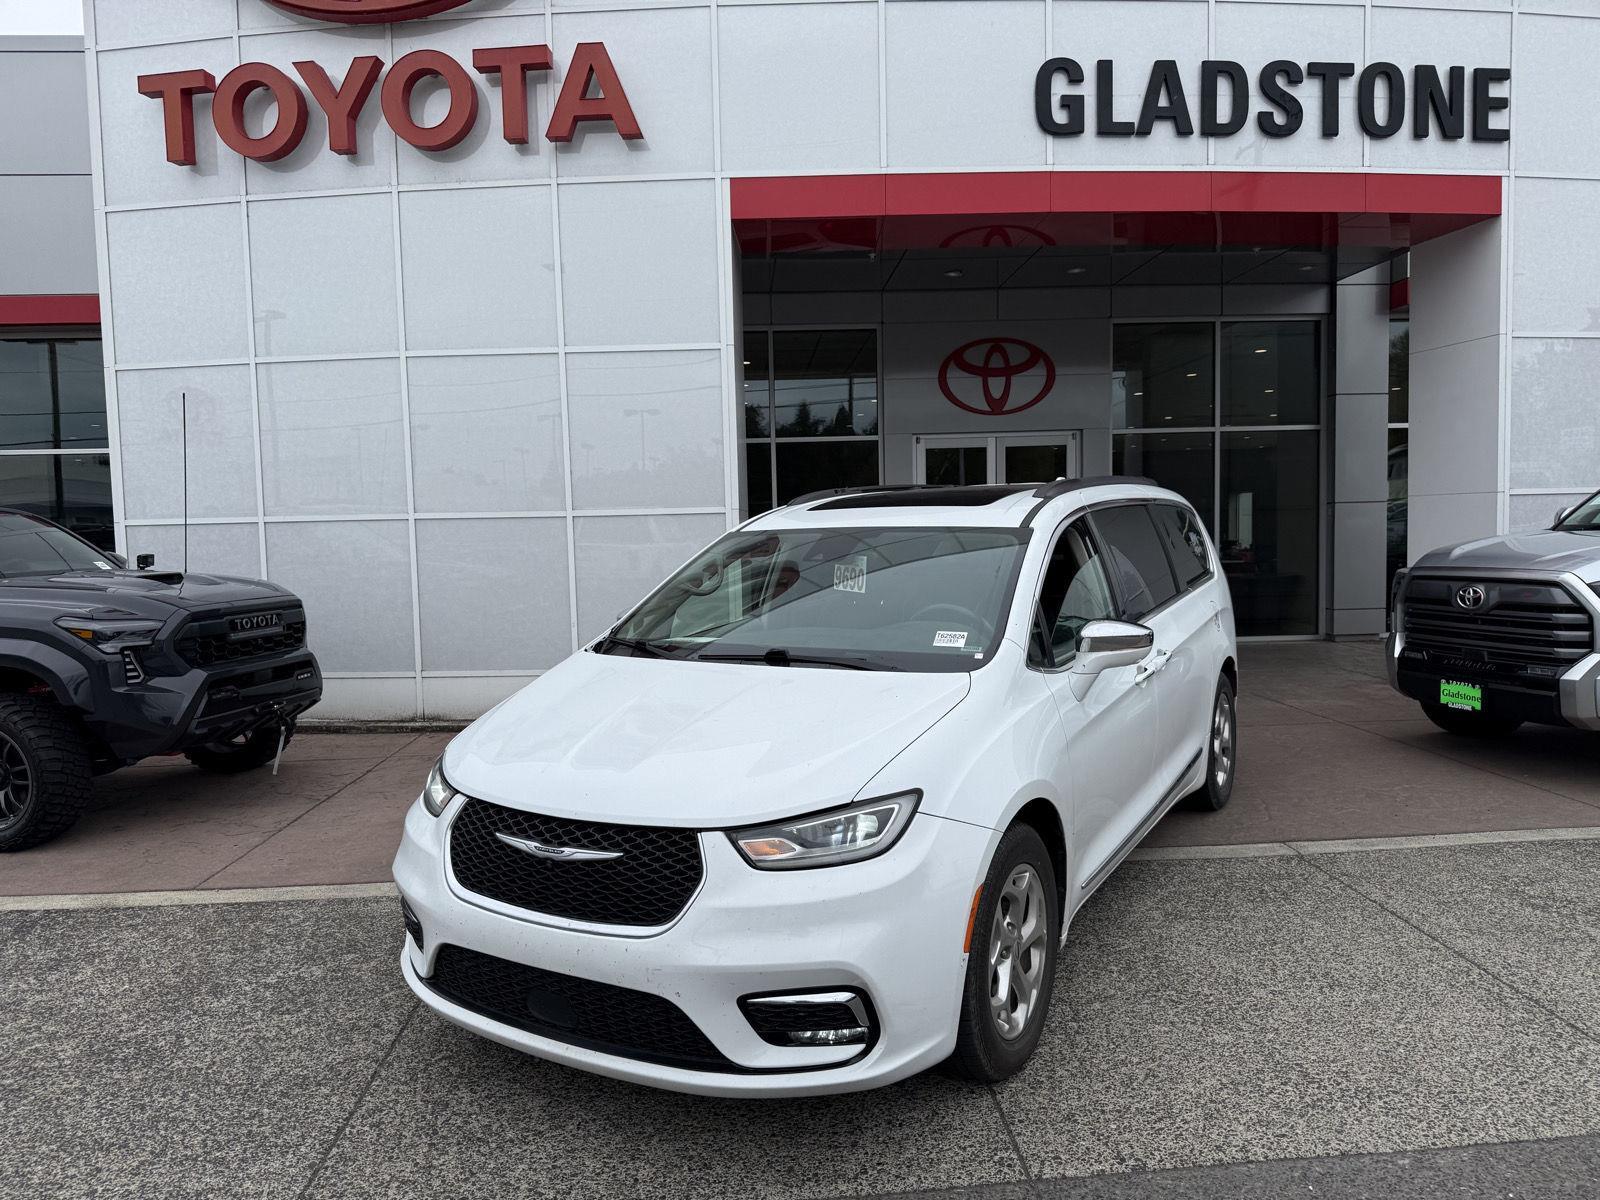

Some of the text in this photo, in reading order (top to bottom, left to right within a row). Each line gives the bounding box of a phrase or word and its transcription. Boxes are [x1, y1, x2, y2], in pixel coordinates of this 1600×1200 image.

[137, 42, 645, 167] TOYOTA
[1035, 57, 1510, 142] GLADSTONE
[835, 565, 865, 591] 9690
[235, 614, 279, 630] TOYOTA
[1442, 689, 1482, 702] Gladstone
